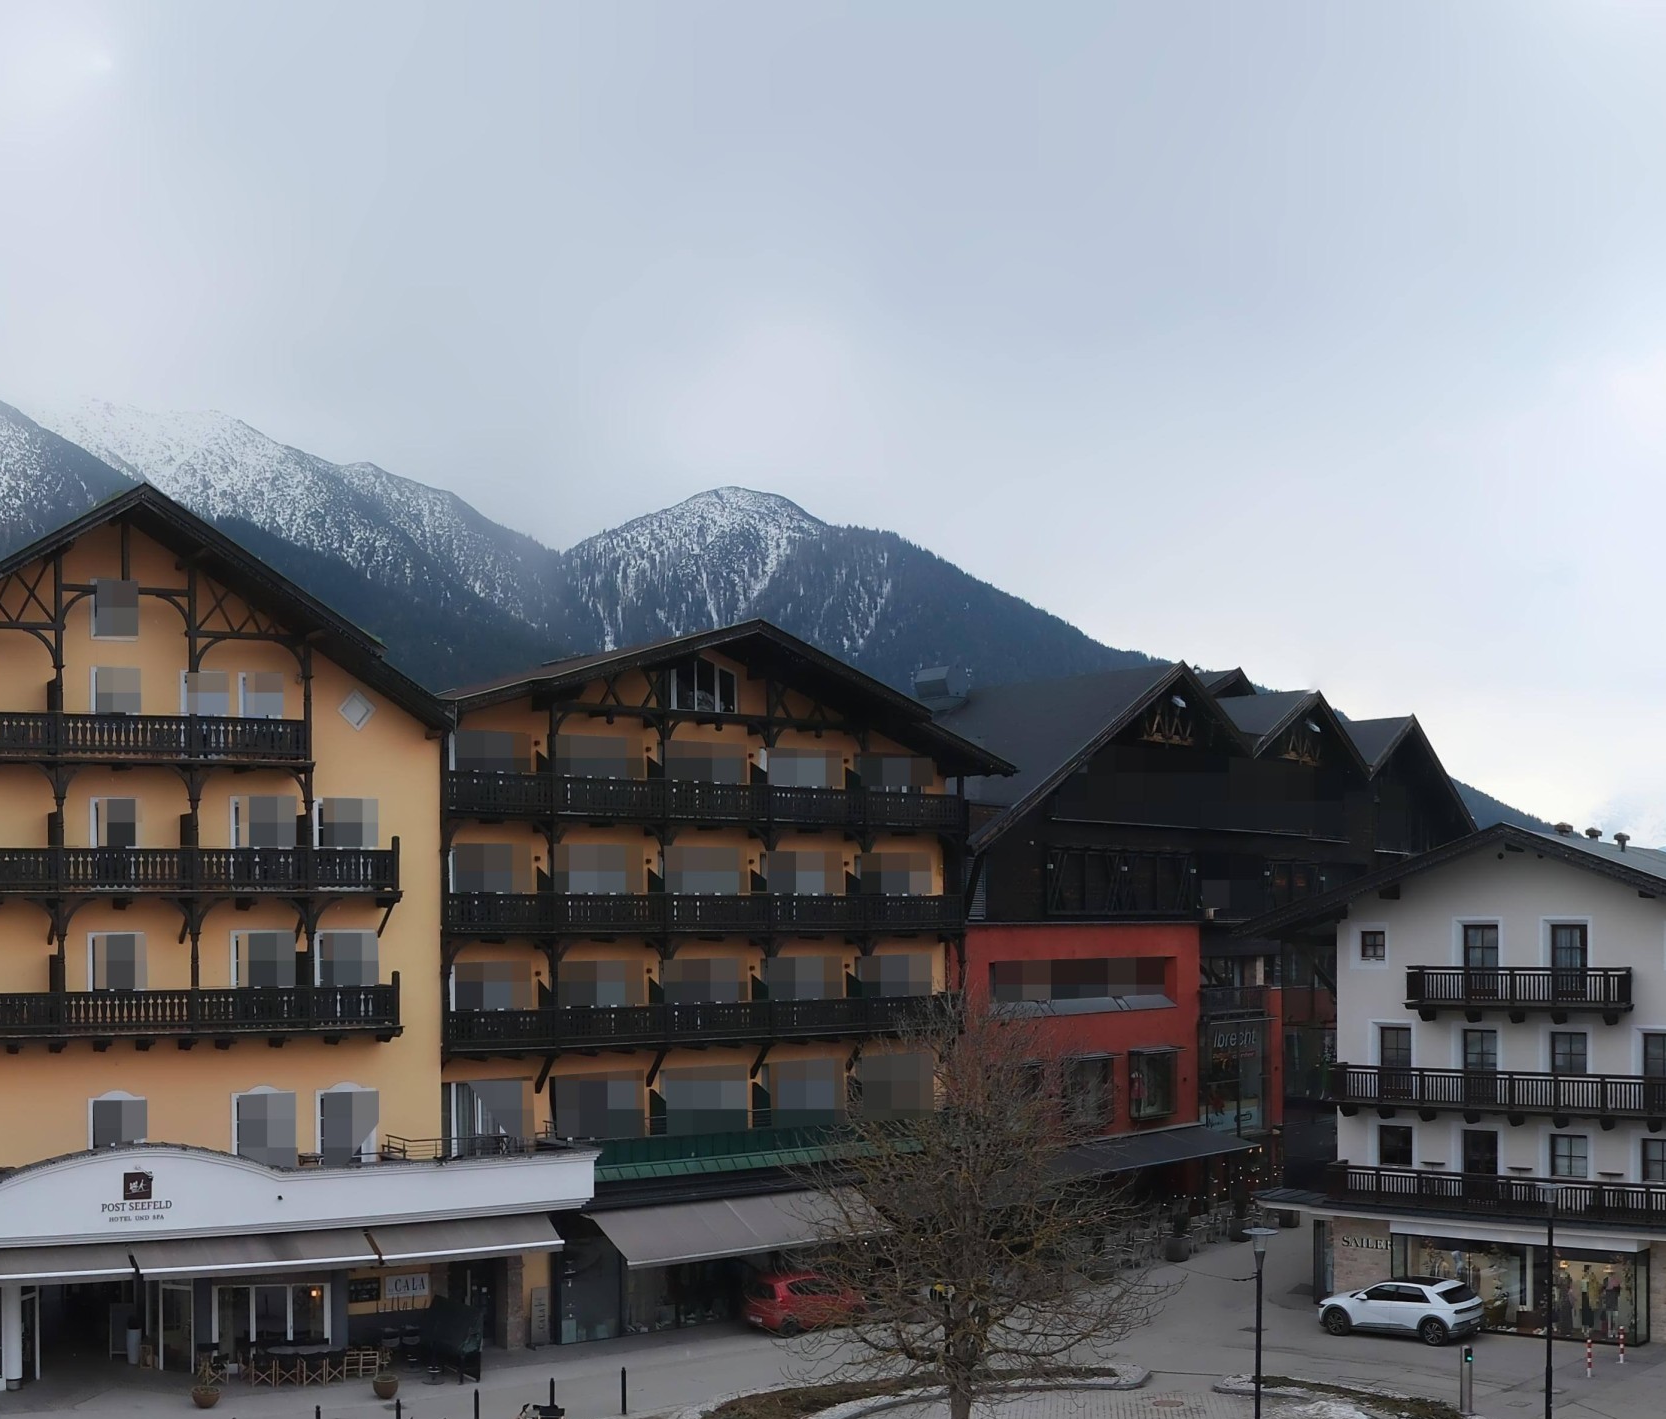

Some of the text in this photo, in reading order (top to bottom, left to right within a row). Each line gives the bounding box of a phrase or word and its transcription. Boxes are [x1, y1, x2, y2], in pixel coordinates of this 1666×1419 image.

[101, 1200, 172, 1213] POST SEEFELD
[395, 1277, 425, 1292] CALA
